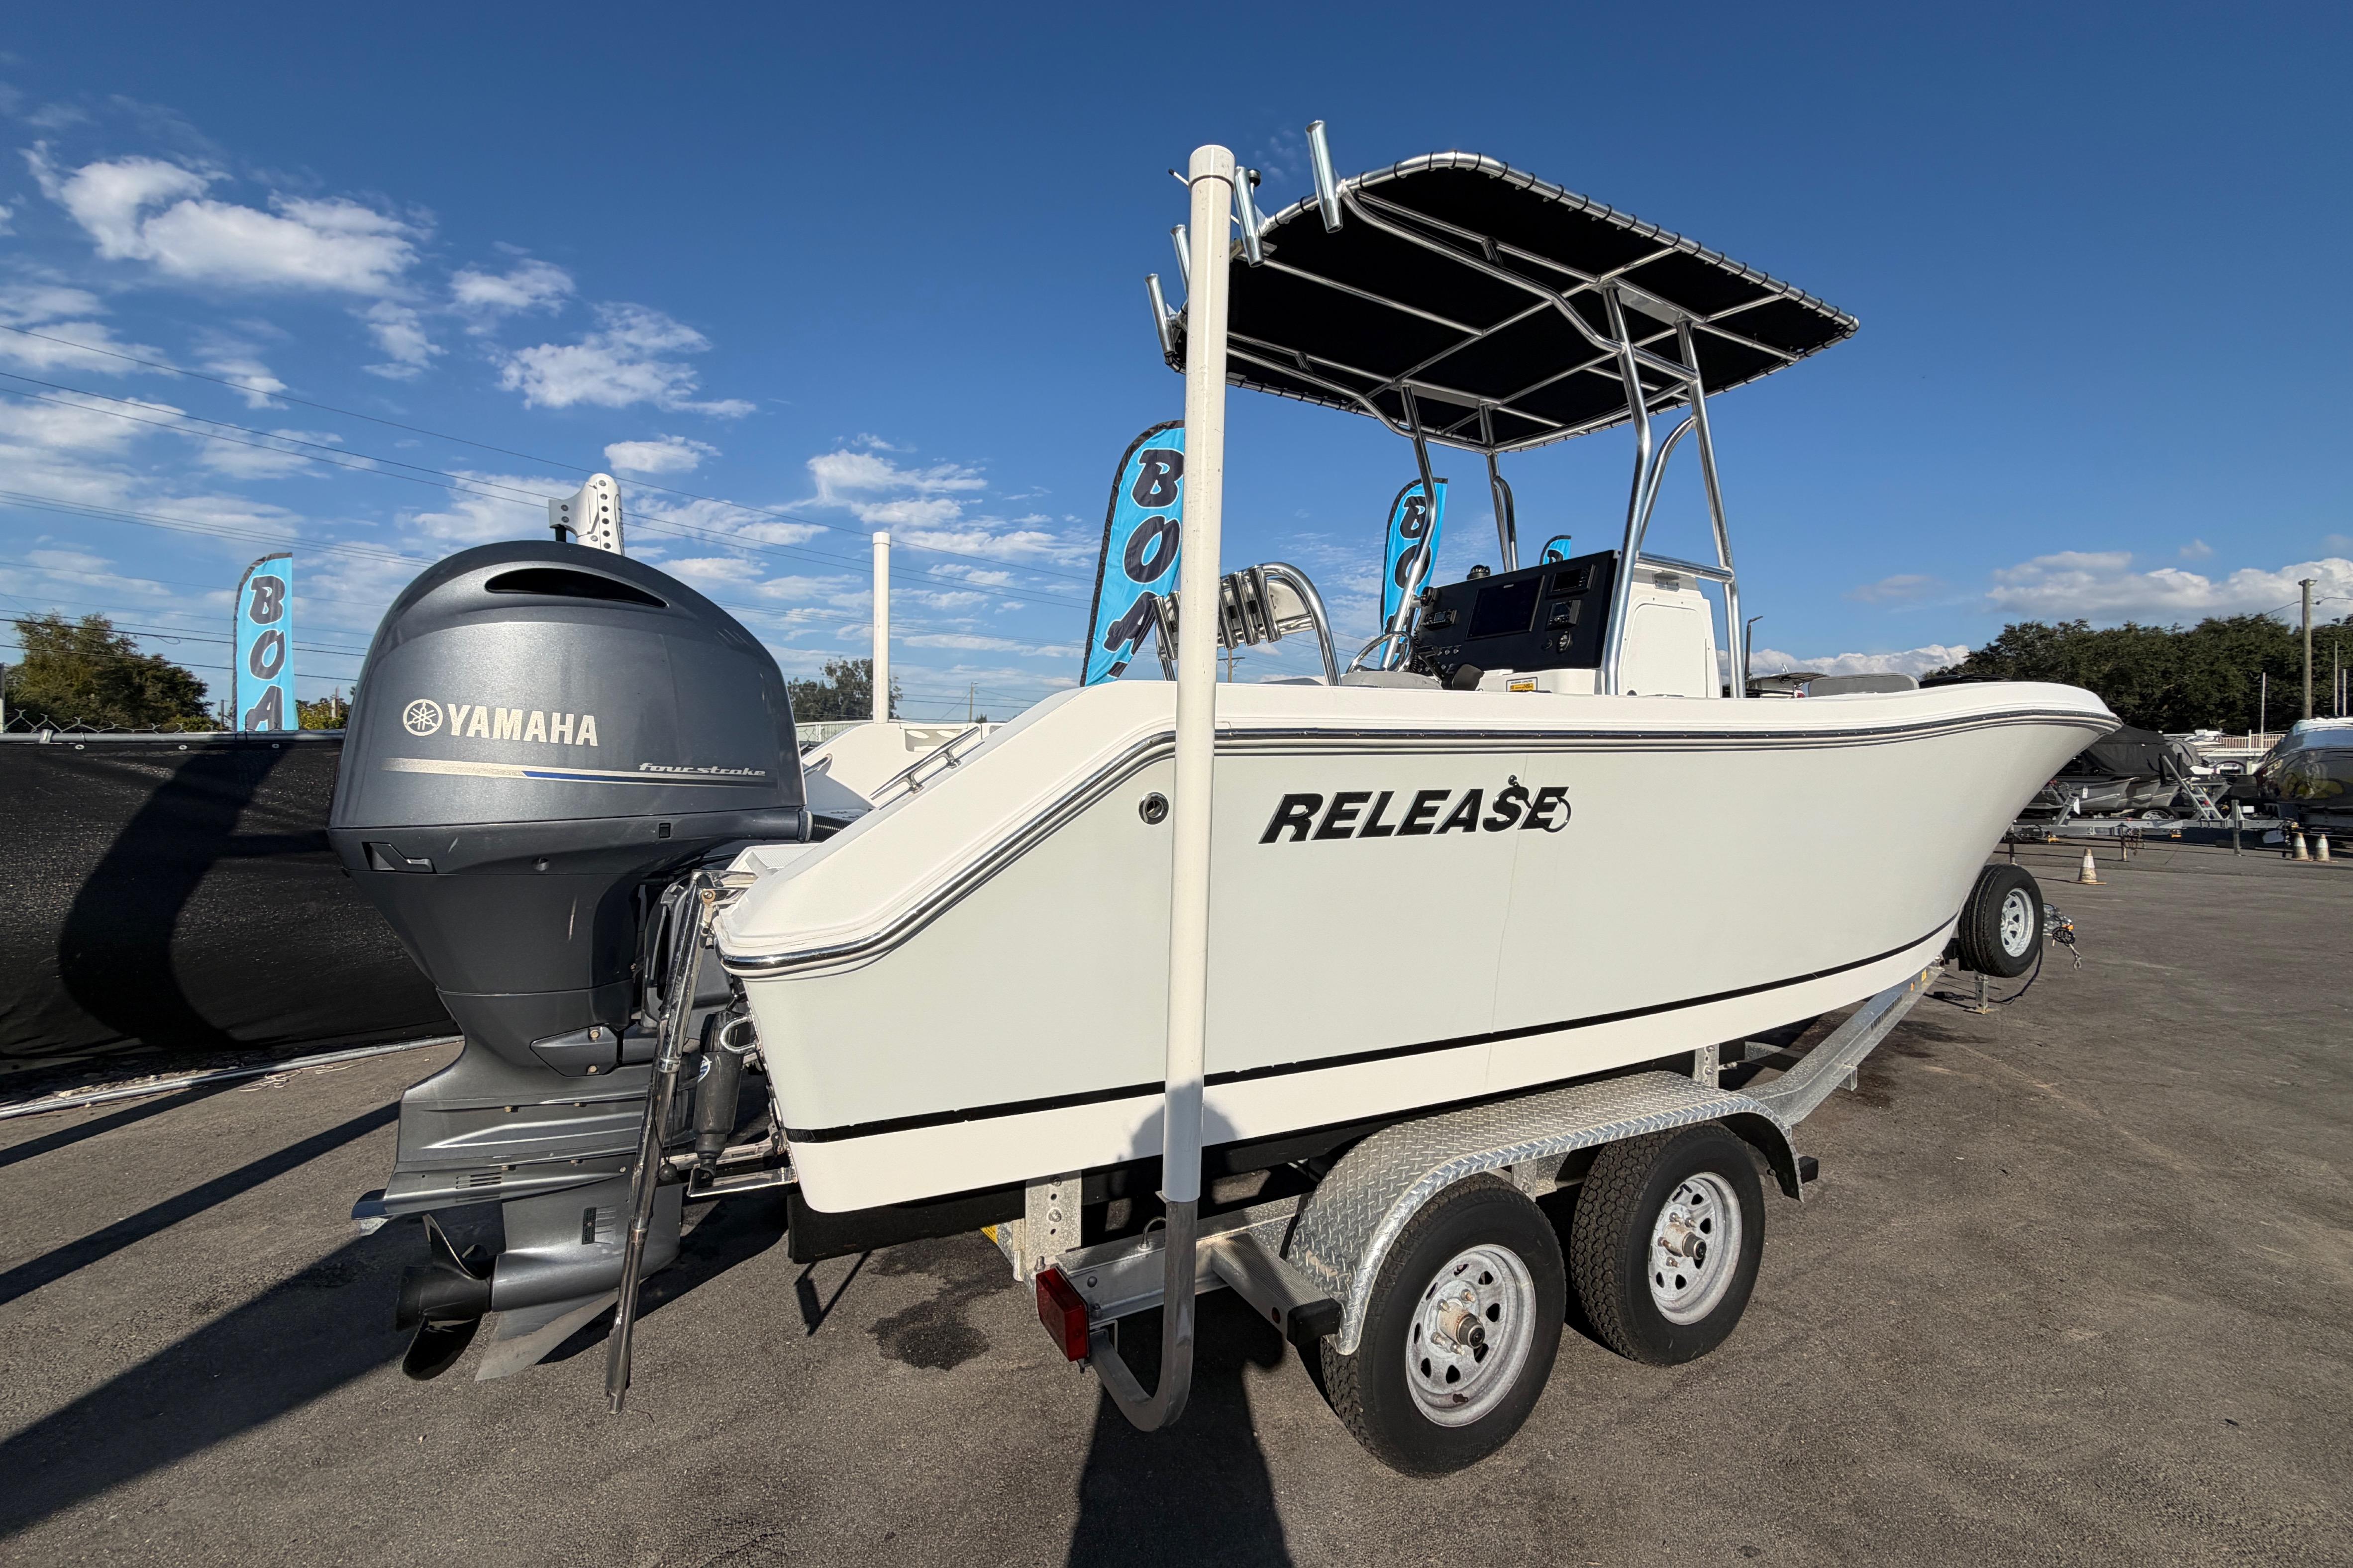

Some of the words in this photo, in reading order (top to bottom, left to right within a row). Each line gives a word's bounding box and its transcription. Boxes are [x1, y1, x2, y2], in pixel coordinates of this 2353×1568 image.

[1103, 448, 1184, 678] BOA
[447, 703, 598, 746] YAMAHA
[1258, 781, 1571, 845] RELEASE
